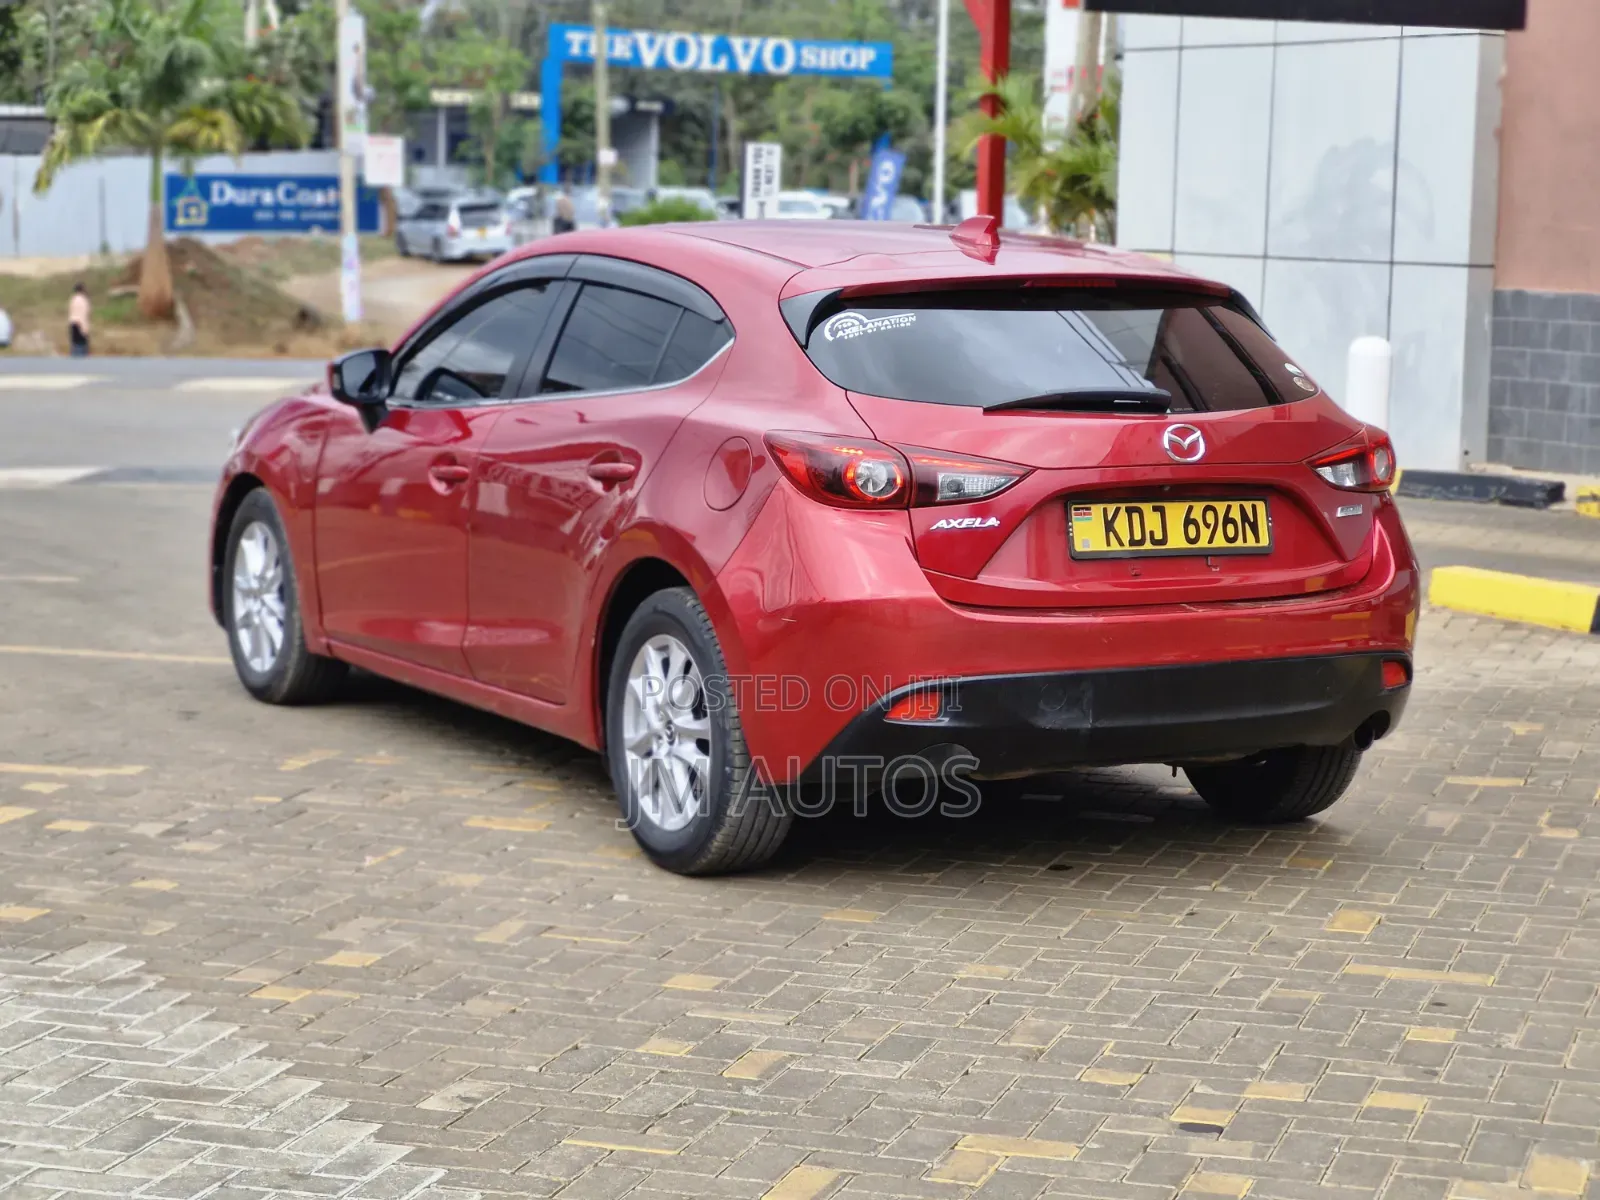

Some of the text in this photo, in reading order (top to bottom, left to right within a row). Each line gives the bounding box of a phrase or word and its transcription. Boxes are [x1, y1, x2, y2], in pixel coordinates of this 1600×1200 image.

[632, 29, 795, 74] VOLVO
[801, 45, 876, 70] SHOP
[836, 315, 917, 338] AXELANATION
[929, 516, 1000, 530] AXELA
[1102, 503, 1260, 547] KDJ 696N
